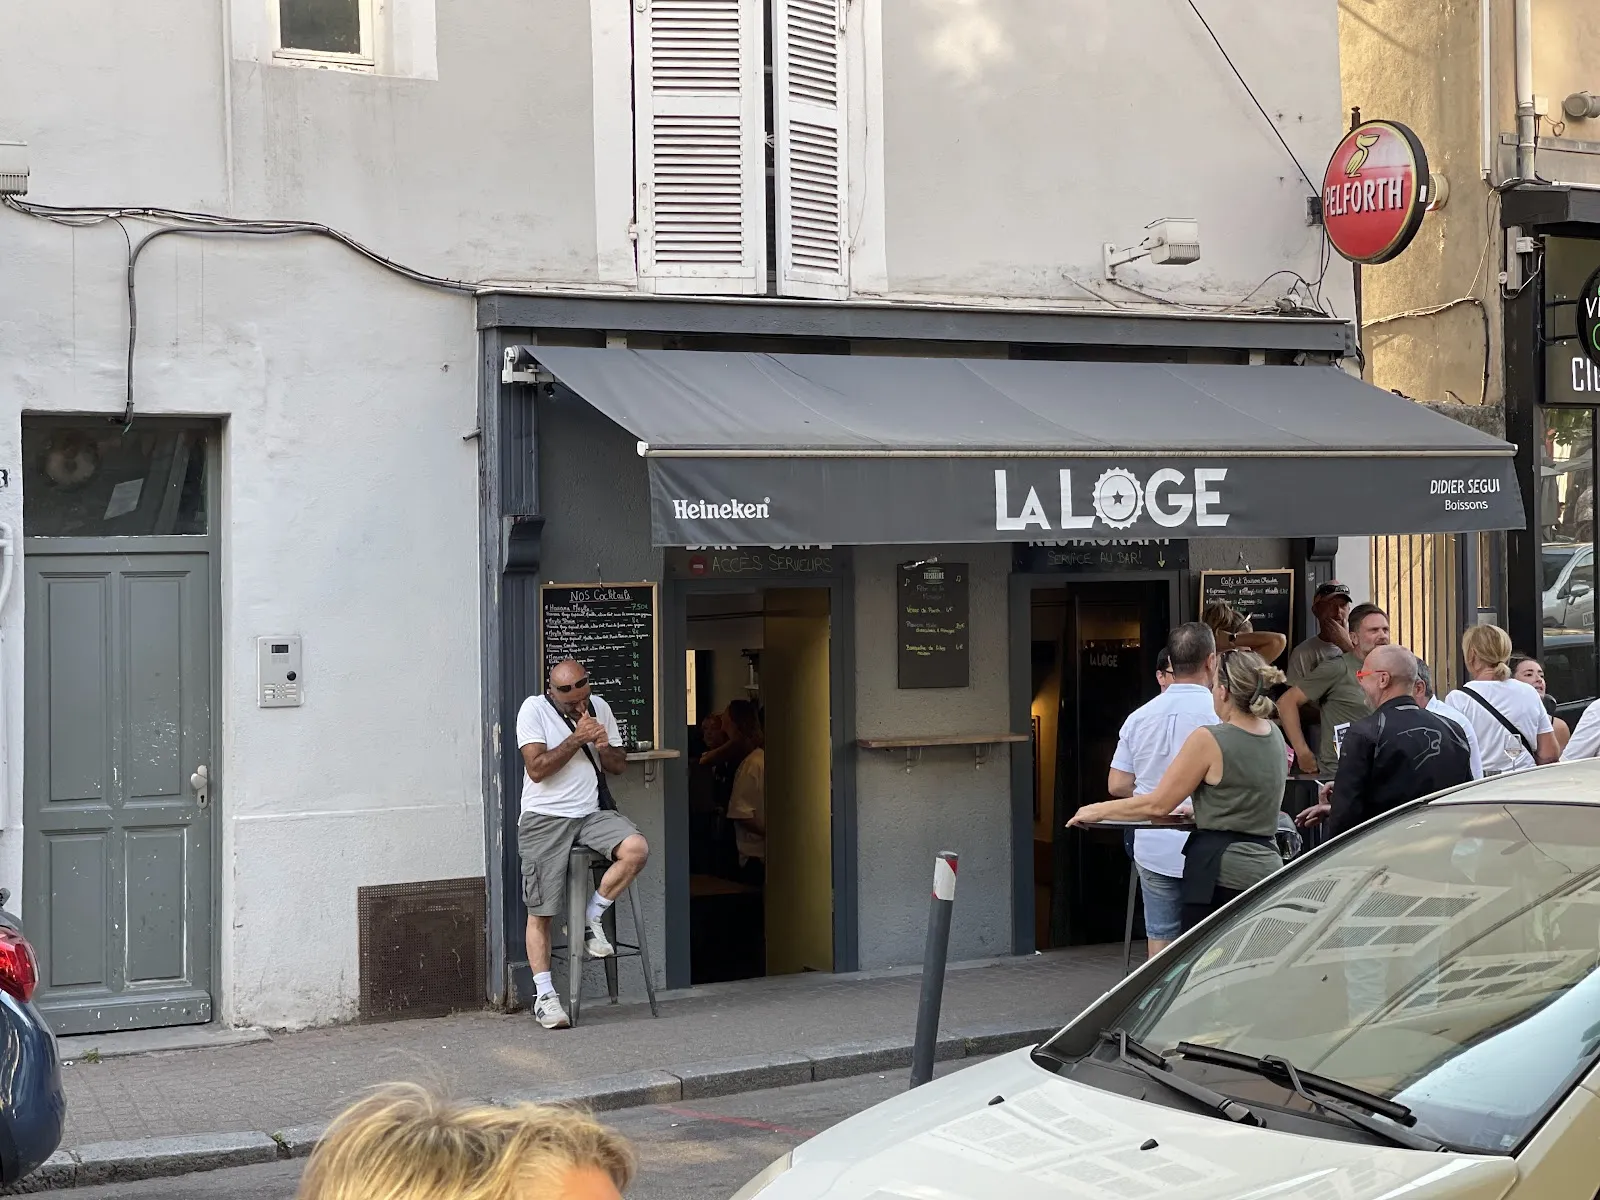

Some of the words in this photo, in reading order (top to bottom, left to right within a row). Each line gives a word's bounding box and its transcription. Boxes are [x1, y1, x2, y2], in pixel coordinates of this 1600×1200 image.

[1325, 177, 1405, 217] PELFORTH
[1430, 479, 1465, 494] DIDIER
[1467, 478, 1501, 494] SEGUI
[1059, 467, 1231, 530] LOGE
[1445, 499, 1489, 511] Boissons
[672, 498, 770, 519] Heineken
[712, 552, 763, 573] ACCÈS
[768, 553, 833, 573] SERVEURS
[1100, 551, 1113, 564] AU
[570, 589, 590, 601] NOS
[593, 588, 631, 601] Cocktails
